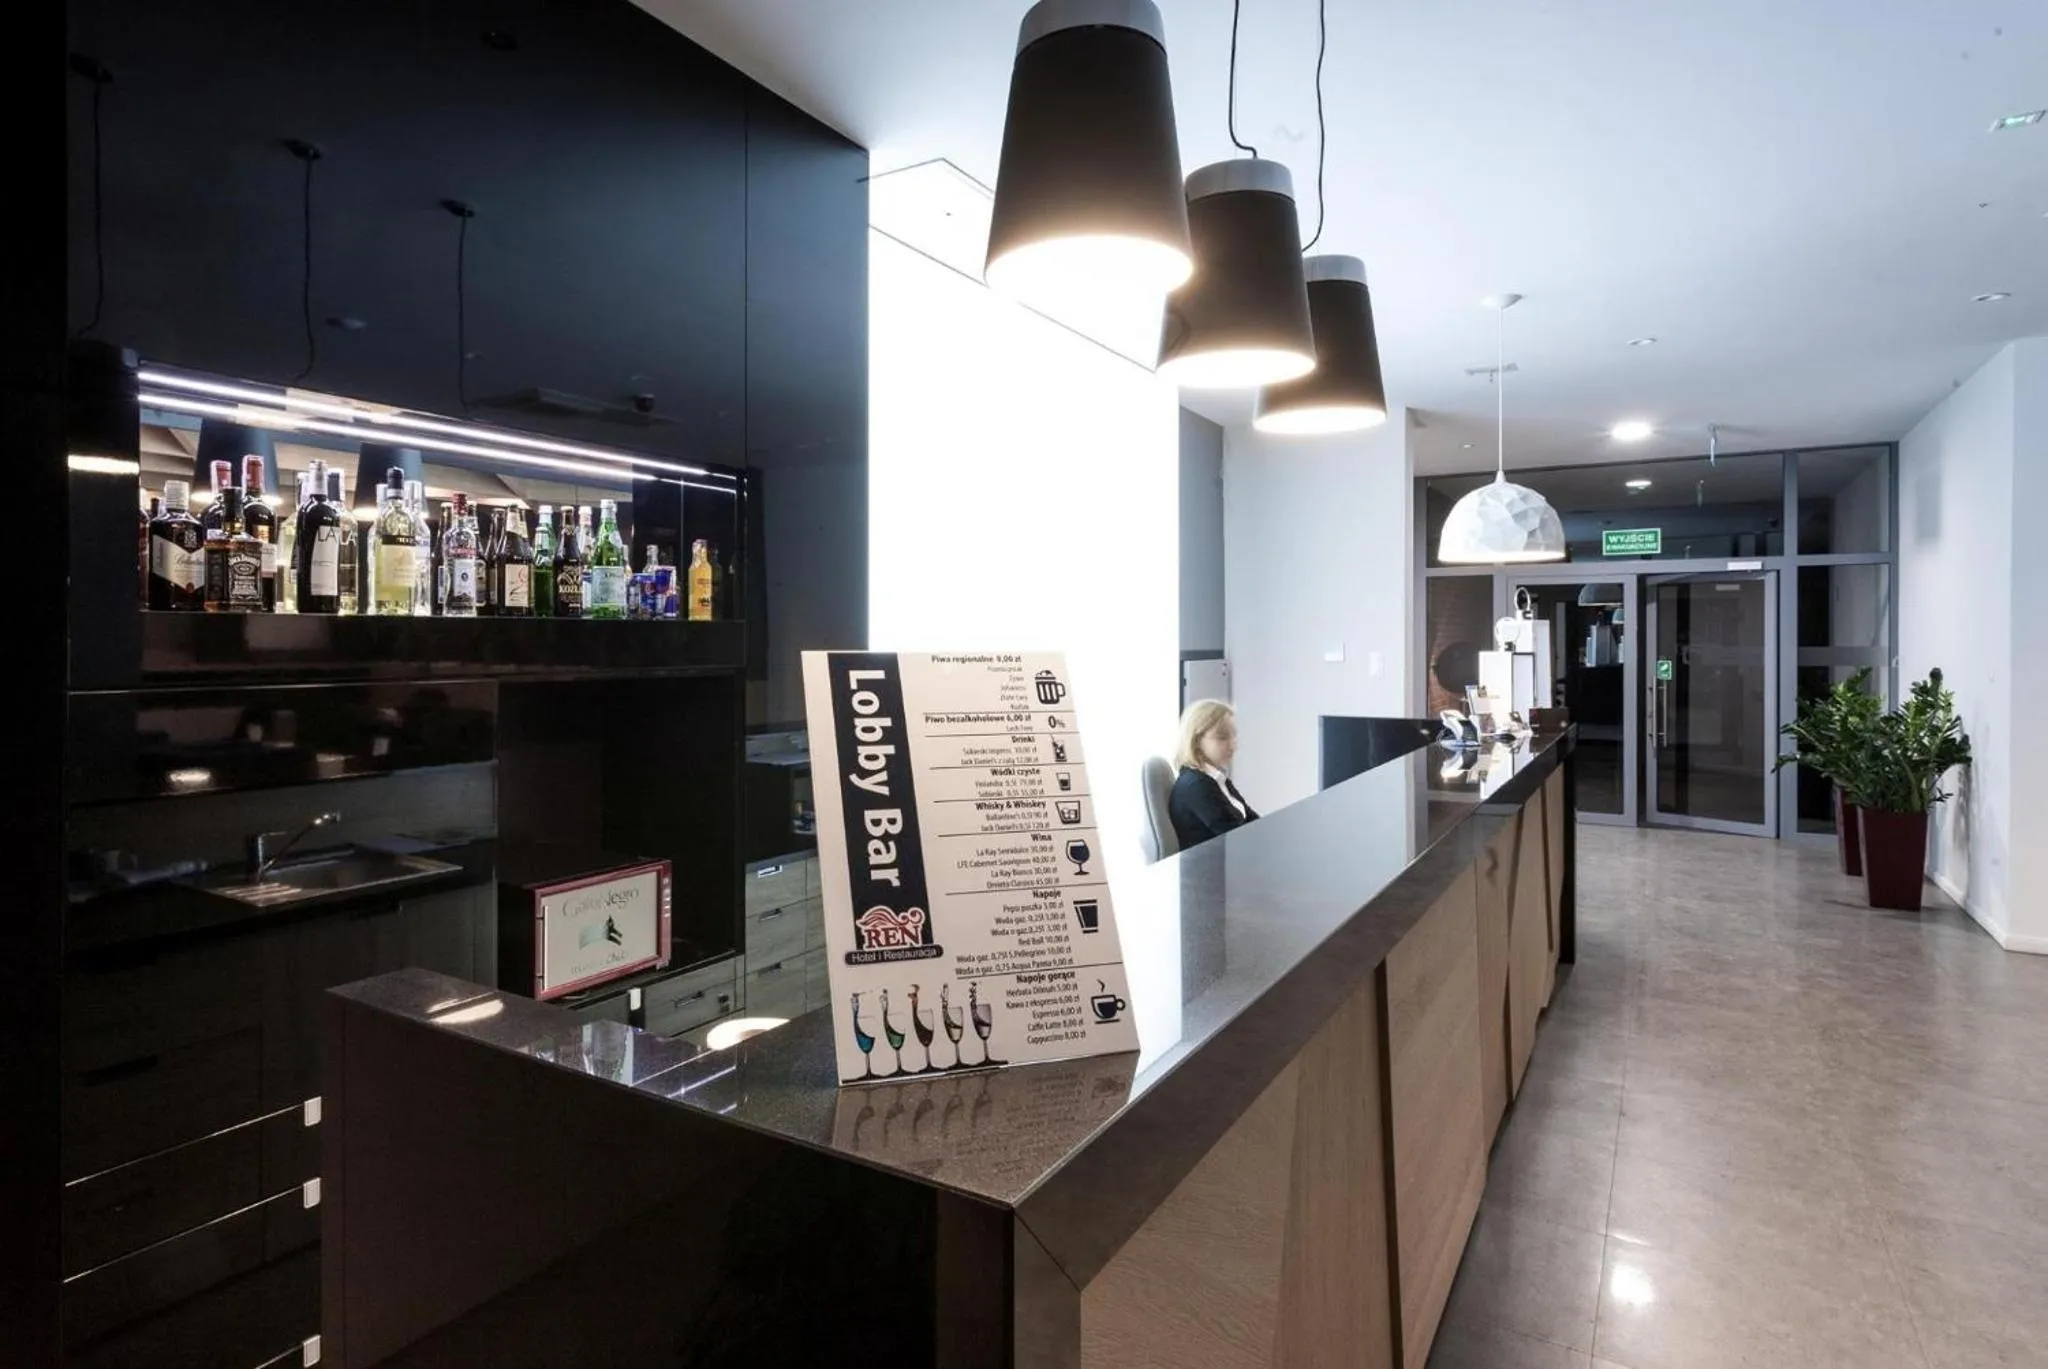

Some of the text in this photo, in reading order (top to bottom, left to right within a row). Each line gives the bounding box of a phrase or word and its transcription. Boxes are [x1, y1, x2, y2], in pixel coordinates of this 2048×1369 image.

[1608, 532, 1656, 544] WYJŚCIE
[1017, 768, 1040, 776] czyste
[848, 670, 903, 888] Lobby Bar
[975, 802, 1004, 811] Whisky
[1014, 800, 1046, 809] Whiskey
[1032, 890, 1061, 899] Napoje
[864, 926, 920, 949] REN
[852, 952, 876, 962] Hotel
[884, 948, 936, 960] Restauracja
[1016, 972, 1076, 983] Napoje gorące
